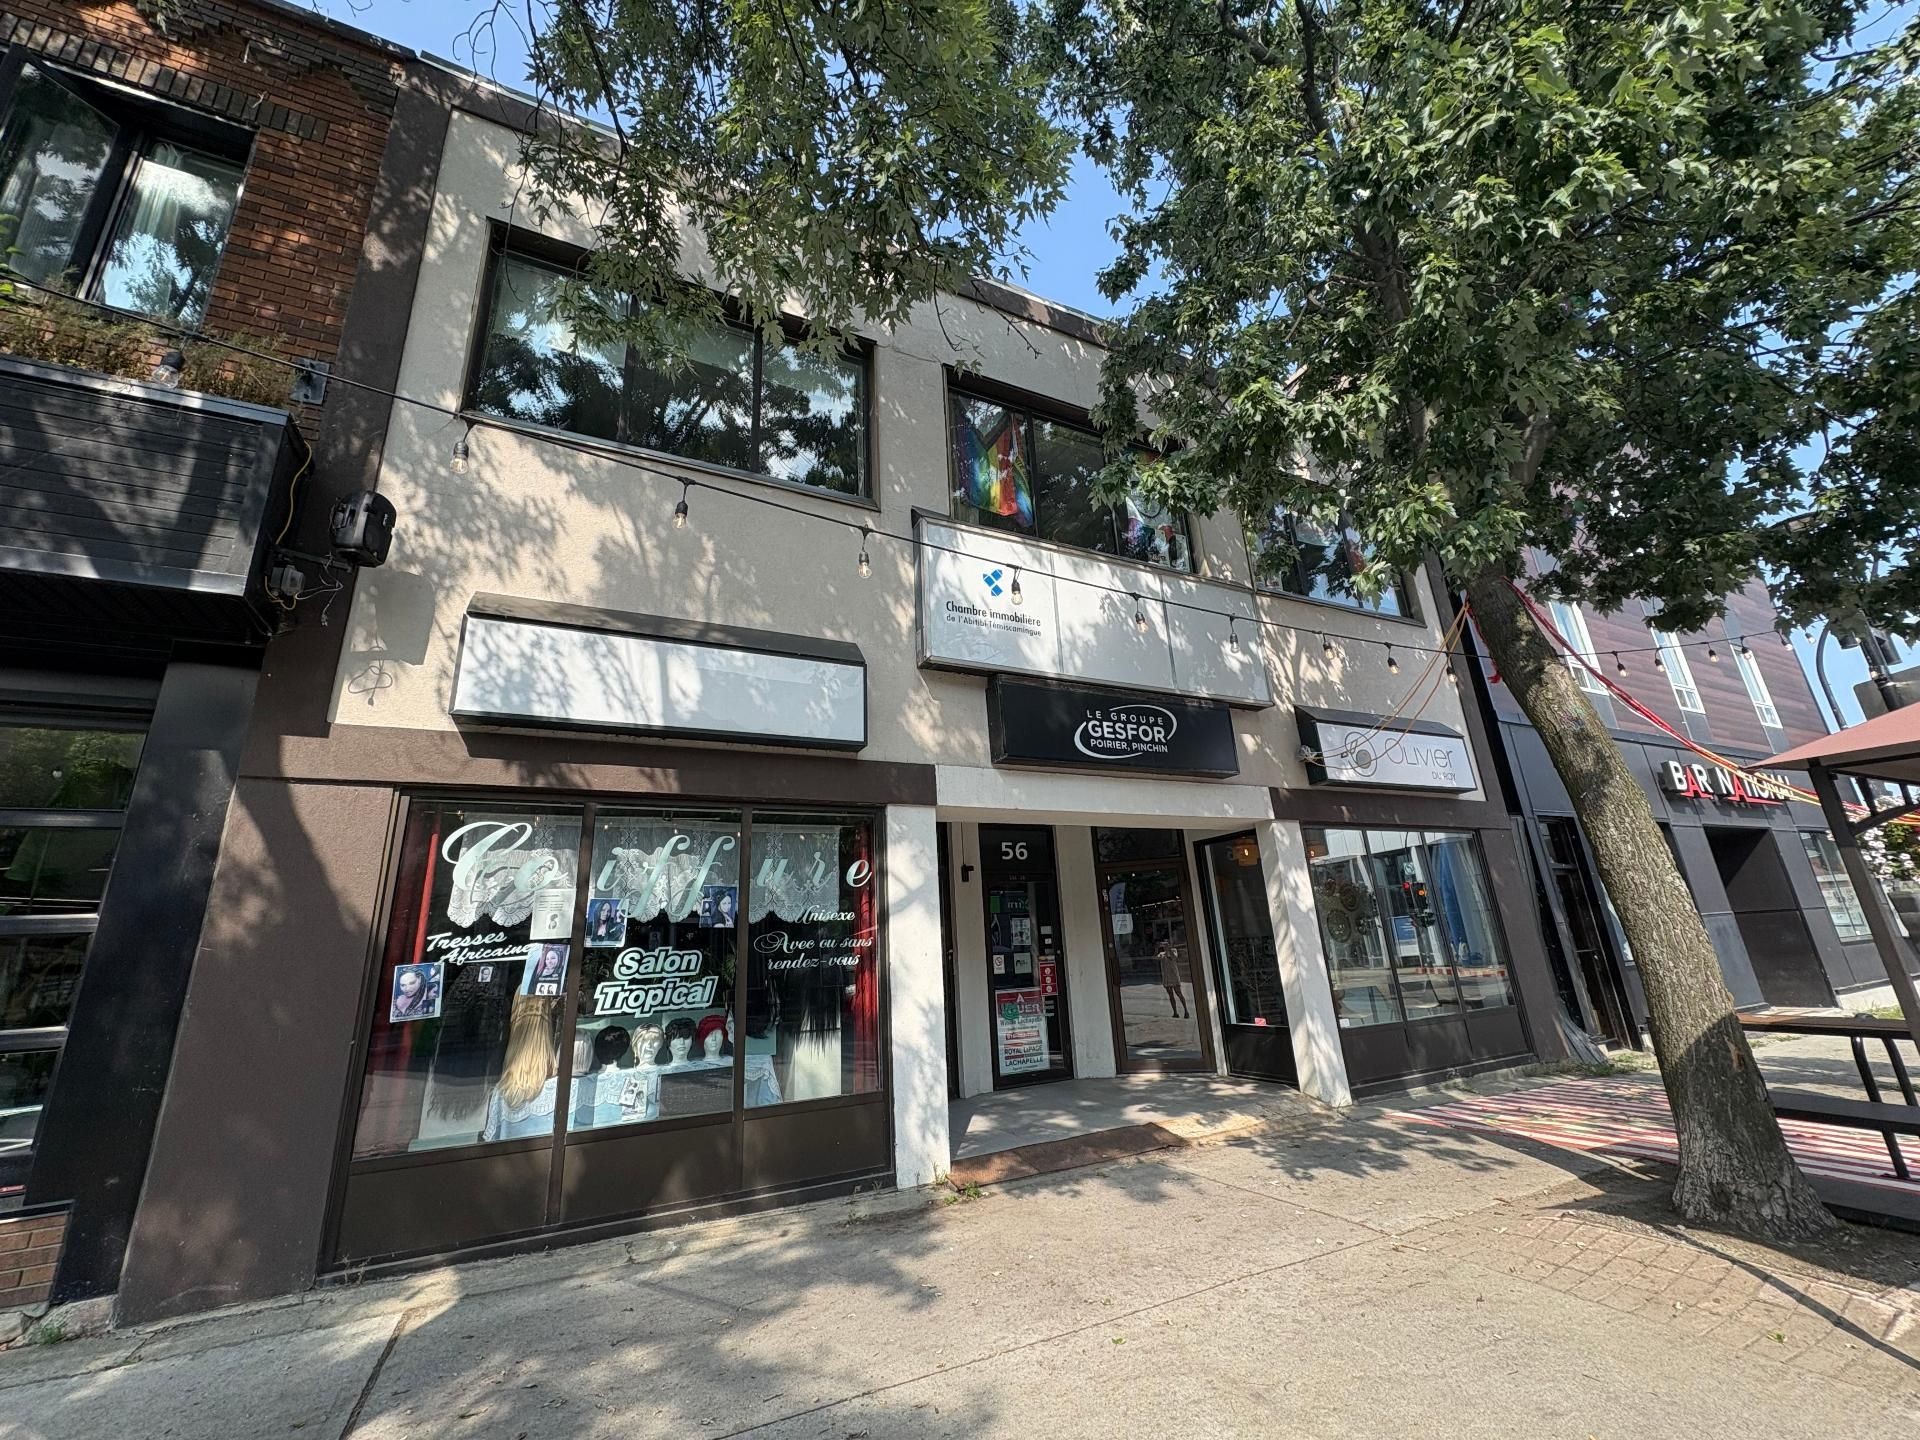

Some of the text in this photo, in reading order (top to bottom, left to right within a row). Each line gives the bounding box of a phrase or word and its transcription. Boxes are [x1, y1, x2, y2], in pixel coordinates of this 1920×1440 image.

[946, 600, 1041, 626] Chambre immobilière
[946, 614, 956, 622] de
[1086, 709, 1164, 726] LE GROUPE
[1087, 720, 1167, 743] GESFOR
[1090, 738, 1168, 753] POIRIER, PINCHIN
[1668, 760, 1714, 799] BAR
[1001, 841, 1028, 860] 56
[441, 821, 873, 918] Coiffure
[795, 904, 856, 925] Unisexe
[426, 931, 507, 952] Tresses
[754, 931, 873, 954] Avec ou sans
[615, 947, 702, 979] Salon
[768, 953, 860, 970] rendez-vous
[596, 977, 718, 1017] Tropical
[1005, 1057, 1044, 1067] LACHAPELLE
